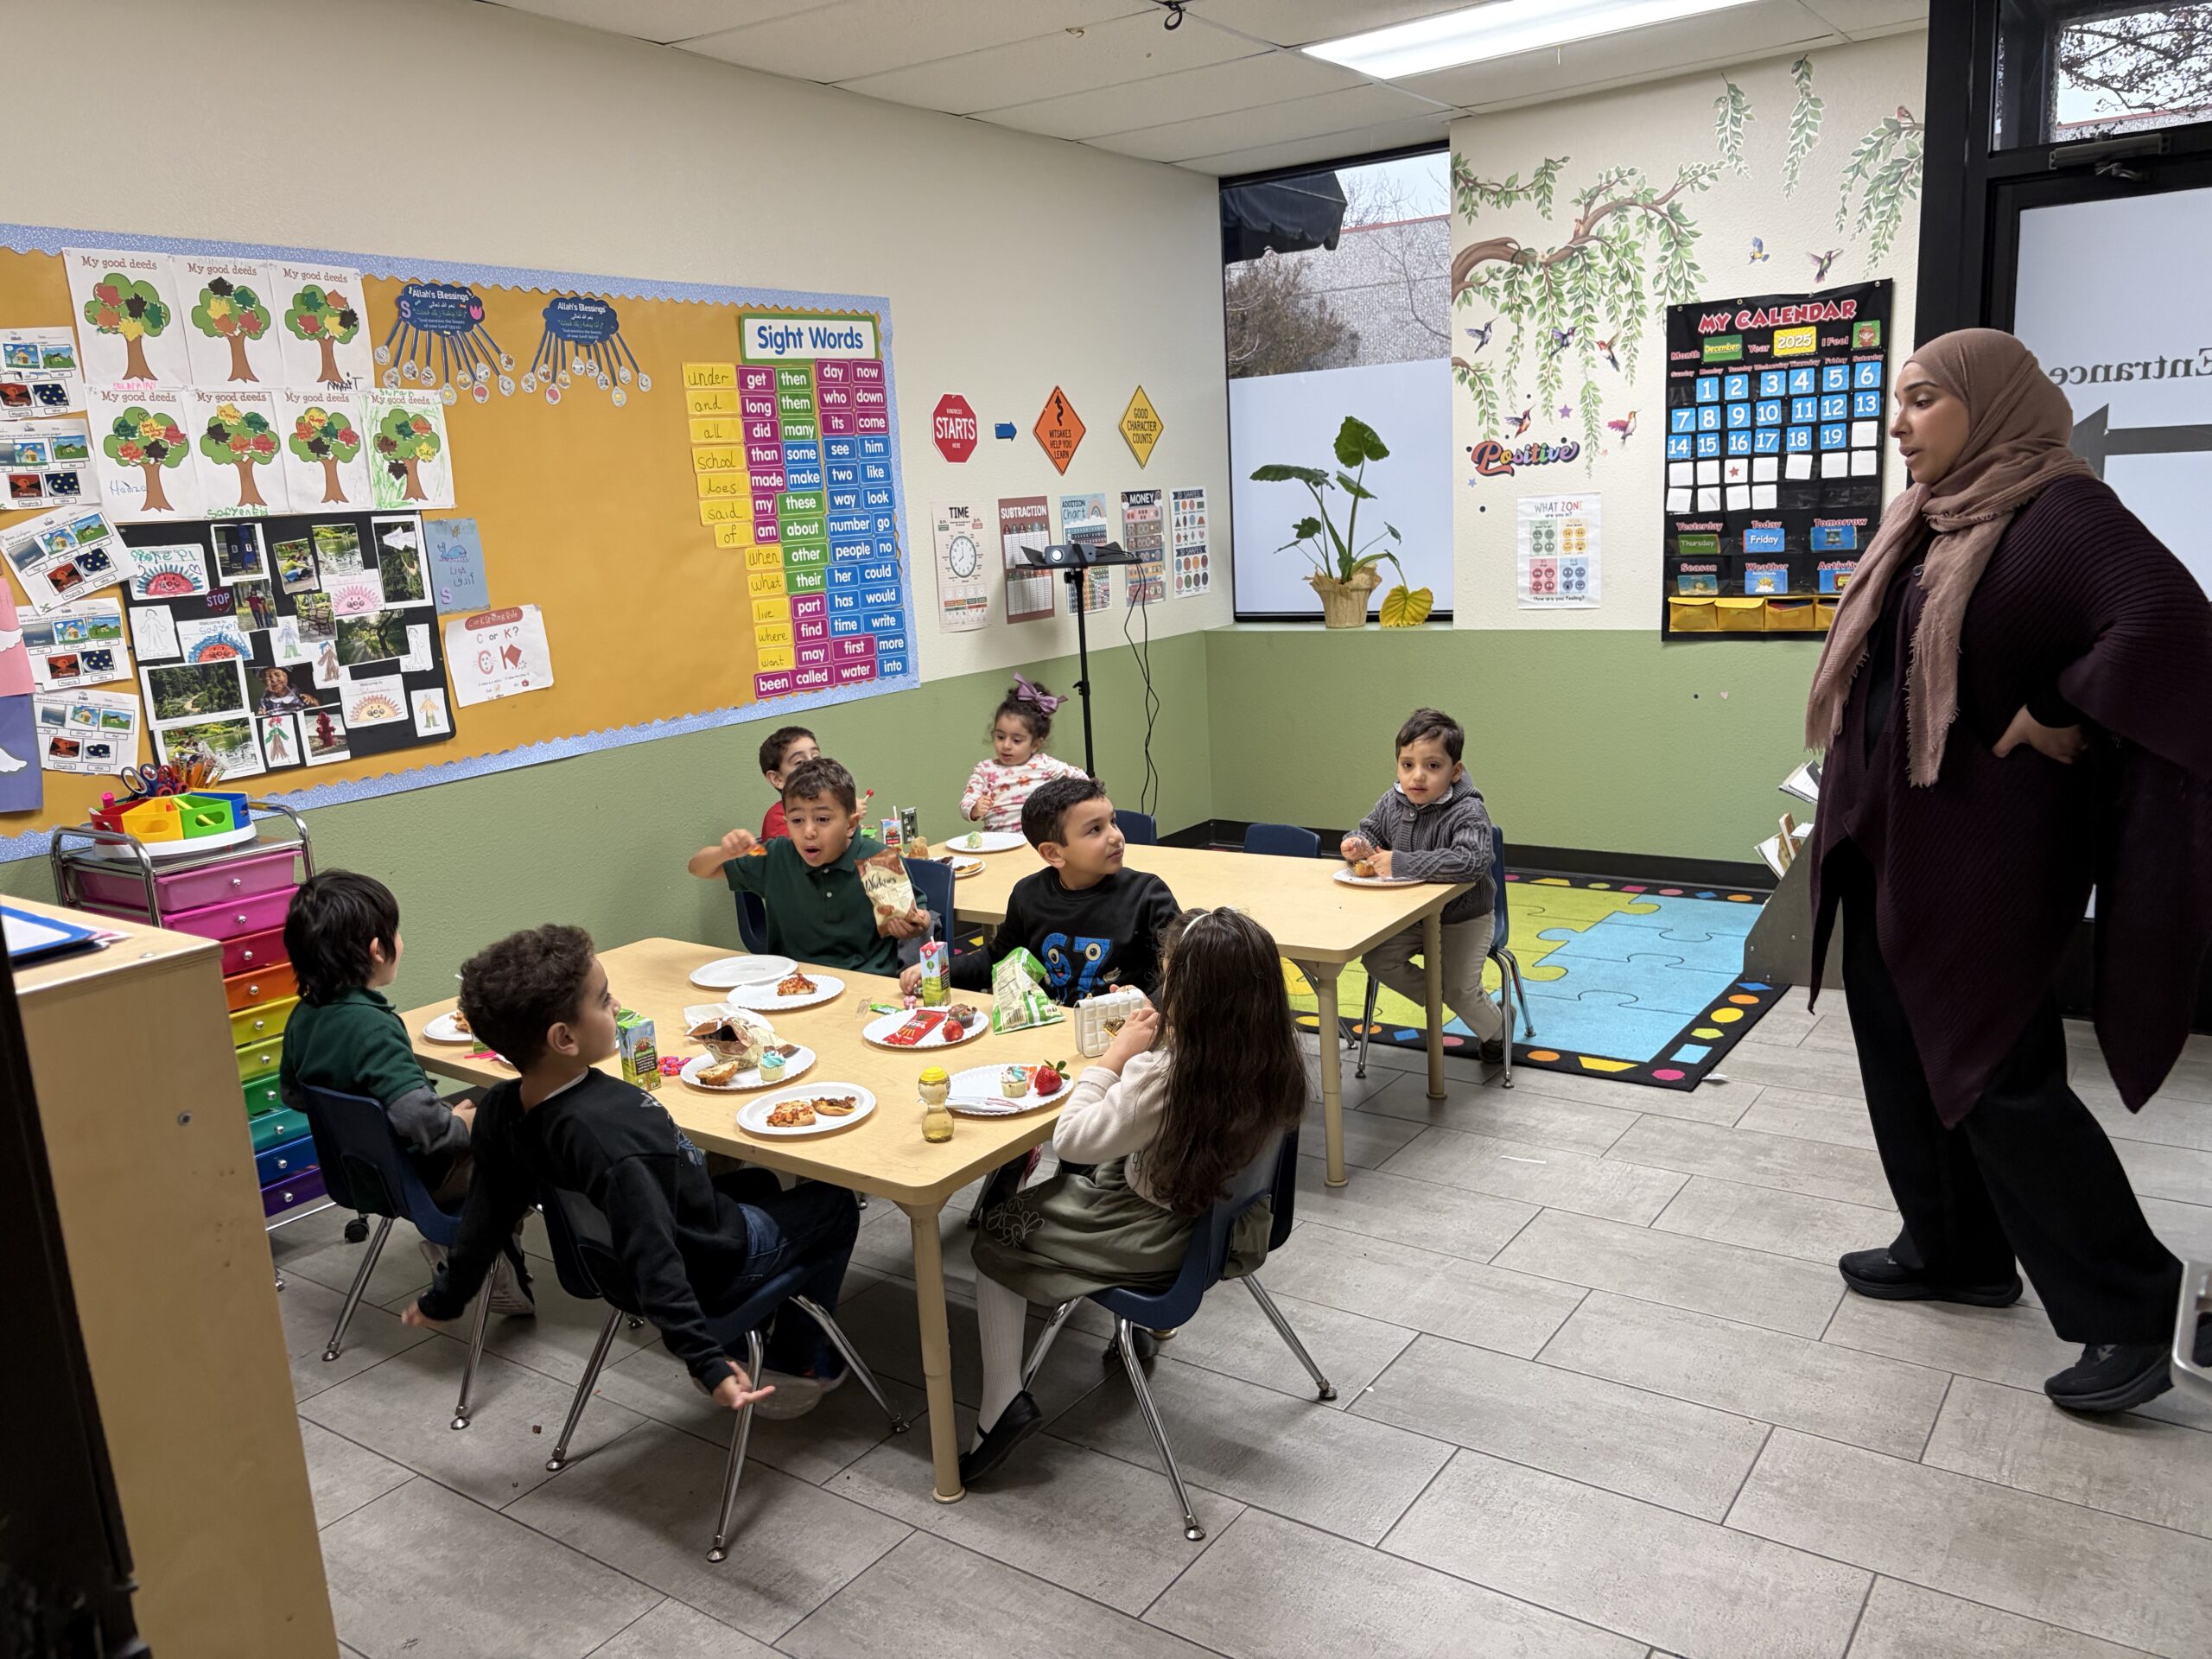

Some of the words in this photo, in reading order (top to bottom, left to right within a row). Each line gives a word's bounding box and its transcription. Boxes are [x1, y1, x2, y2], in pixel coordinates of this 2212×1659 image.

[81, 256, 99, 268] My
[102, 257, 126, 269] good
[130, 258, 157, 270] deeds
[188, 263, 205, 276] My
[207, 264, 230, 276] good
[232, 265, 257, 276] deeds
[283, 268, 299, 281] My
[301, 270, 321, 282] good
[324, 271, 348, 283] deeds
[412, 289, 435, 299] Allah's
[437, 292, 469, 302] Blessings
[557, 302, 577, 311] Allah's
[579, 303, 606, 315] Blessings
[1698, 313, 1732, 334] MY
[1735, 299, 1857, 330] CALENDAR
[757, 326, 804, 355] Sight
[809, 326, 863, 349] Words
[1671, 350, 1700, 360] Month
[1705, 343, 1740, 353] December
[1747, 344, 1770, 353] Year
[1777, 334, 1812, 349] 2025
[1827, 336, 1849, 346] Feel
[1754, 361, 1789, 371] Wednesday
[1789, 359, 1821, 368] Thursday
[689, 368, 728, 386] under
[781, 372, 806, 385] then
[823, 365, 843, 381] day
[857, 367, 878, 378] now
[747, 373, 766, 389] get
[1703, 382, 1711, 398] 1
[1731, 378, 1742, 395] 2
[1766, 376, 1778, 392] 3
[1794, 372, 1808, 390] 4
[1829, 369, 1842, 387] 5
[1861, 366, 1873, 384] 6
[101, 392, 119, 404] My
[122, 392, 146, 403] good
[149, 391, 177, 403] deeds
[196, 392, 213, 404] My
[215, 393, 238, 404] good
[239, 392, 267, 402] deeds
[284, 393, 300, 404] My
[302, 393, 324, 404] good
[326, 393, 350, 403] deeds
[371, 395, 386, 405] My
[387, 394, 406, 404] good
[408, 395, 430, 404] deeds
[695, 394, 721, 412] and
[781, 397, 810, 410] them
[823, 392, 847, 404] who
[856, 391, 883, 404] down
[747, 400, 772, 416] long
[1134, 408, 1147, 419] GOOD
[1676, 412, 1689, 429] 7
[1703, 410, 1714, 427] 8
[1732, 408, 1745, 425] 9
[1758, 404, 1778, 422] 10
[1796, 403, 1813, 418] 11
[1824, 399, 1843, 416] 12
[1857, 396, 1876, 411] 13
[831, 416, 844, 429] its
[859, 417, 886, 428] come
[936, 416, 976, 440] STARTS
[1127, 420, 1157, 432] CHARACTER
[704, 424, 722, 438] all
[753, 424, 771, 438] did
[785, 424, 814, 439] many
[1050, 440, 1061, 448] HELP
[1063, 440, 1071, 448] YOU
[1133, 434, 1153, 444] COUNTS
[1669, 439, 1688, 454] 14
[1700, 437, 1716, 452] 15
[1731, 435, 1747, 451] 16
[1758, 433, 1777, 448] 17
[1790, 431, 1808, 446] 18
[1824, 429, 1842, 444] 19
[831, 445, 849, 455] see
[864, 440, 884, 453] him
[752, 448, 778, 461] than
[787, 449, 817, 460] some
[1055, 450, 1069, 459] LEARN
[1471, 441, 1580, 476] Positive
[697, 454, 736, 469] school
[790, 471, 820, 484] make
[832, 469, 853, 480] two
[867, 466, 884, 478] like
[752, 474, 783, 487] made
[834, 494, 855, 507] way
[868, 491, 888, 504] look
[1129, 493, 1154, 504] MONEY
[1183, 490, 1200, 499] SHAPES
[755, 499, 773, 512] my
[785, 497, 816, 509] these
[1062, 499, 1085, 508] ADDITION
[1535, 502, 1558, 512] WHAT
[1561, 501, 1583, 512] ZONE
[708, 502, 743, 520] said
[949, 506, 969, 518] TIME
[1001, 505, 1047, 519] SUBTRACTION
[1064, 508, 1085, 520] Chart
[830, 518, 869, 531] number
[877, 517, 890, 529] go
[1676, 522, 1723, 531] Yesterday
[1751, 520, 1782, 529] Today
[1814, 518, 1867, 527] Tomorrow
[724, 524, 738, 544] of
[758, 526, 776, 537] am
[786, 523, 819, 536] about
[1681, 539, 1714, 548] Thursday
[1751, 535, 1778, 545] Friday
[836, 543, 871, 557] people
[880, 543, 892, 552] no
[1186, 547, 1203, 556] SHAPES
[748, 549, 780, 564] when
[791, 548, 820, 561] other
[865, 565, 892, 579] could
[1681, 563, 1717, 572] Season
[796, 574, 821, 587] their
[835, 570, 852, 582] her
[751, 575, 782, 591] what
[207, 592, 230, 607] STOP
[836, 595, 854, 607] has
[866, 588, 896, 602] would
[758, 606, 774, 620] live
[798, 599, 821, 615] part
[834, 619, 858, 632] time
[871, 615, 896, 628] write
[758, 628, 788, 642] where
[801, 623, 822, 637] find
[844, 640, 865, 654] first
[879, 639, 905, 650] more
[801, 649, 825, 663] may
[761, 658, 785, 668] want
[884, 661, 902, 672] into
[796, 670, 828, 684] called
[841, 664, 870, 678] water
[760, 677, 789, 691] been
